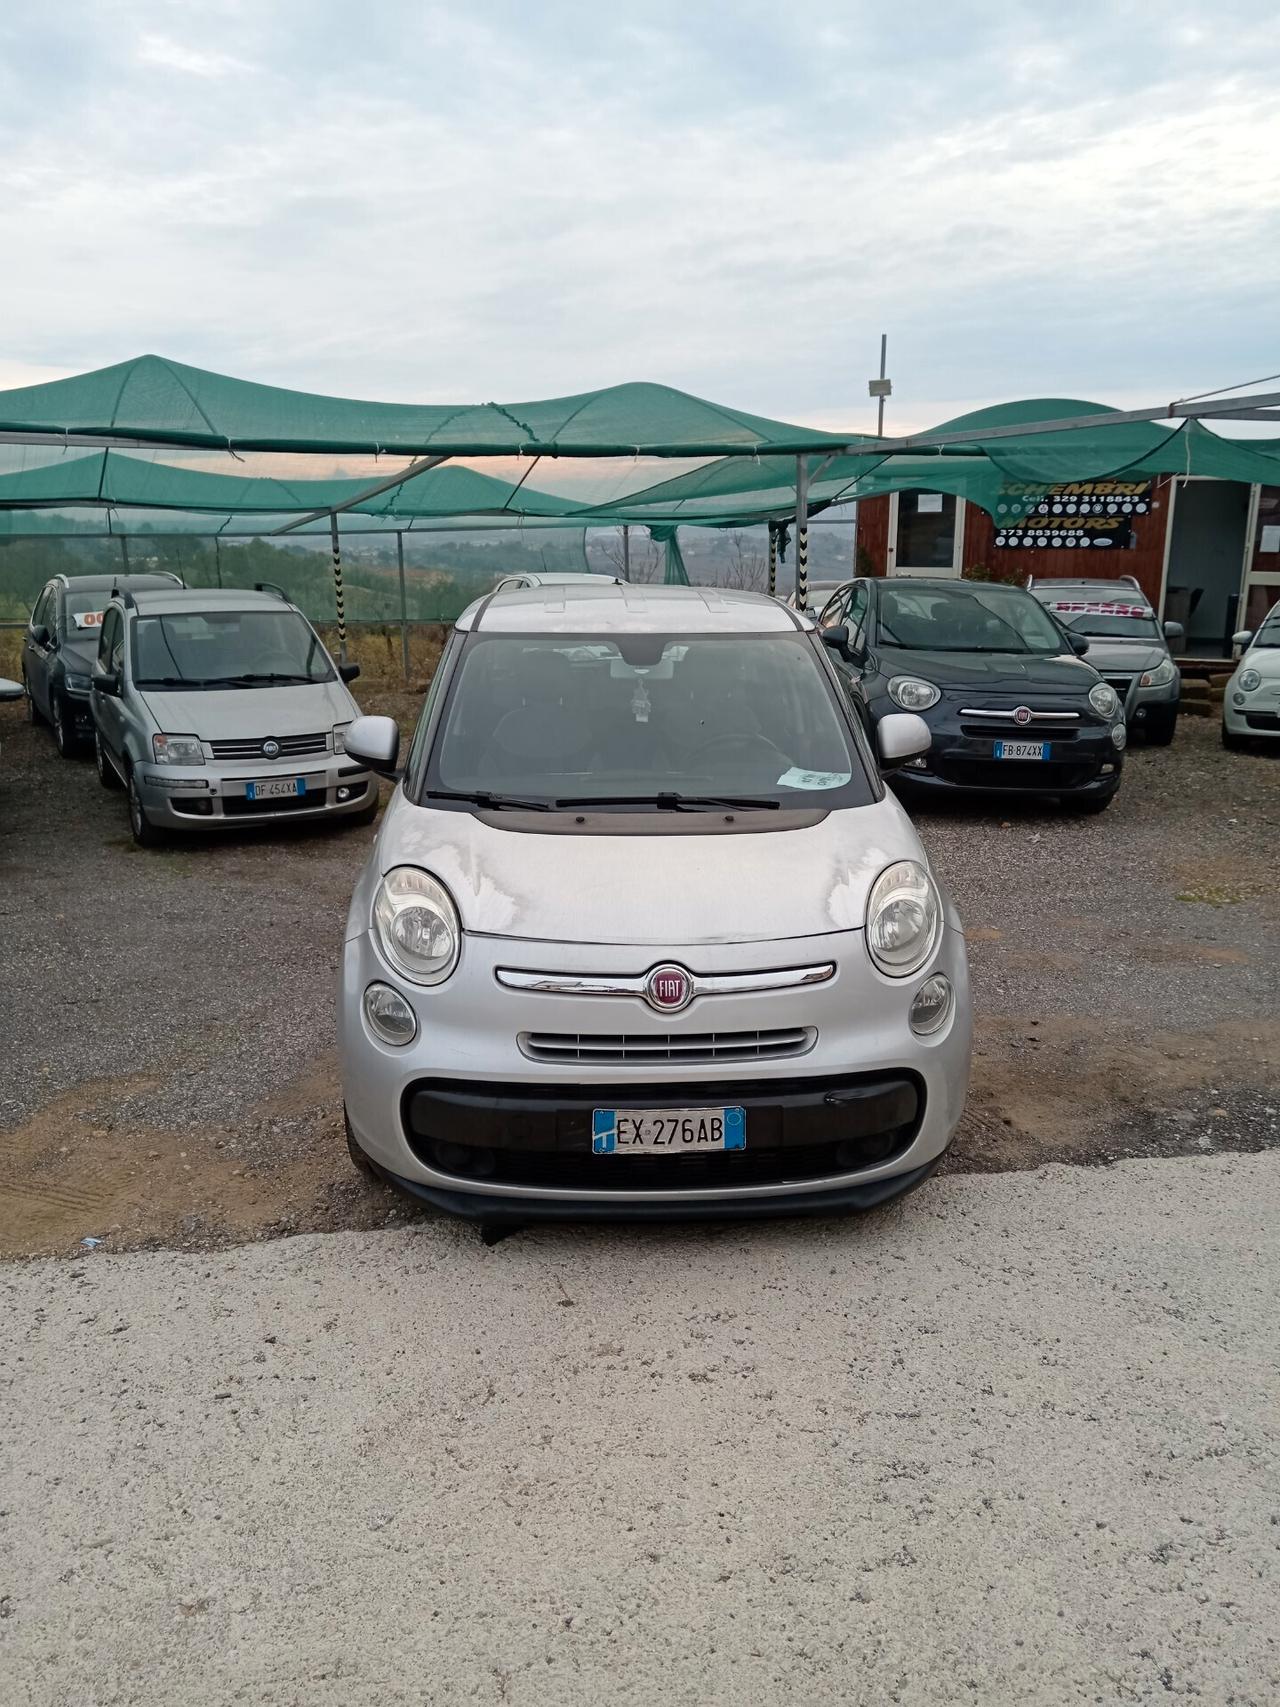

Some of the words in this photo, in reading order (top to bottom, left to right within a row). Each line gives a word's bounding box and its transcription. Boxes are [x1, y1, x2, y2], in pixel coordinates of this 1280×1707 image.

[1016, 745, 1043, 757] 874XX
[659, 979, 681, 998] FIAT
[616, 1118, 644, 1145] EX
[652, 1116, 724, 1145] 276AB
